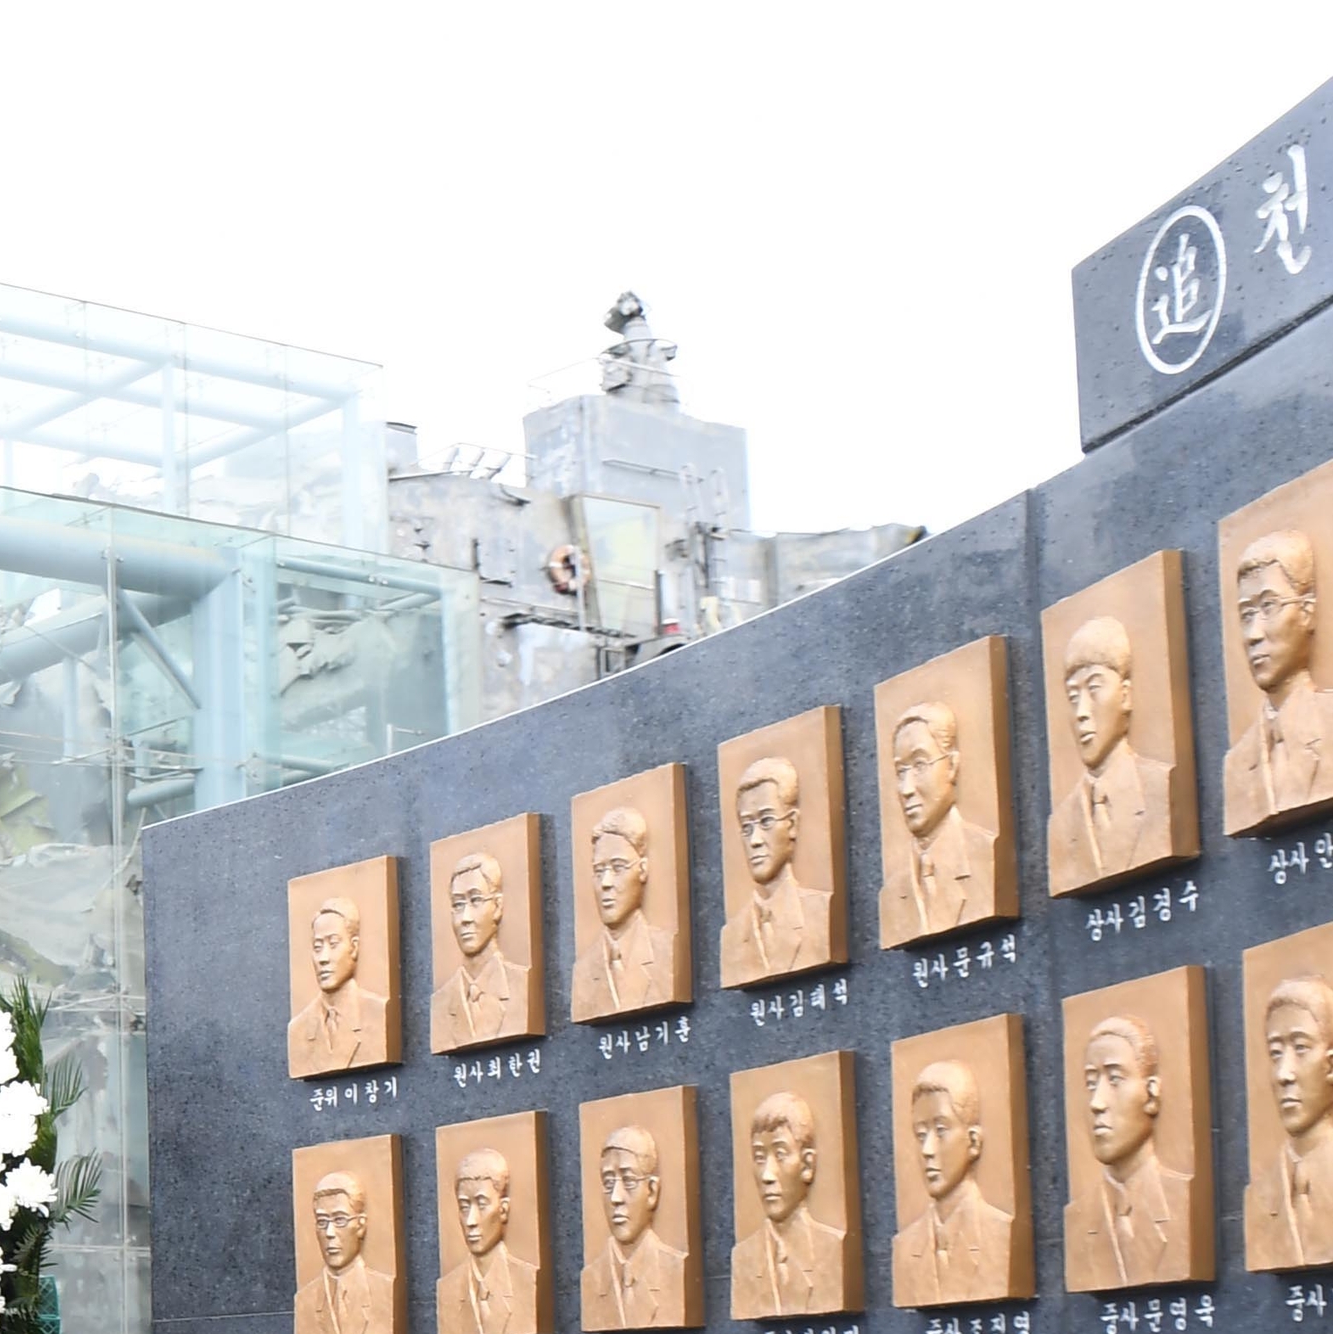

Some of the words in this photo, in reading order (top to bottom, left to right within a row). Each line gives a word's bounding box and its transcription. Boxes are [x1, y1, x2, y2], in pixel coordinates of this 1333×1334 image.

[1151, 232, 1213, 345] 追
[1252, 143, 1312, 275] 천
[1267, 842, 1310, 885] 상사
[1085, 902, 1124, 942] 상사
[912, 953, 949, 988] 원사
[750, 995, 785, 1027] 원사
[599, 1030, 631, 1060] 원사
[453, 1060, 484, 1088] 원사
[309, 1085, 338, 1112] 준위
[1285, 1284, 1327, 1322] 중사
